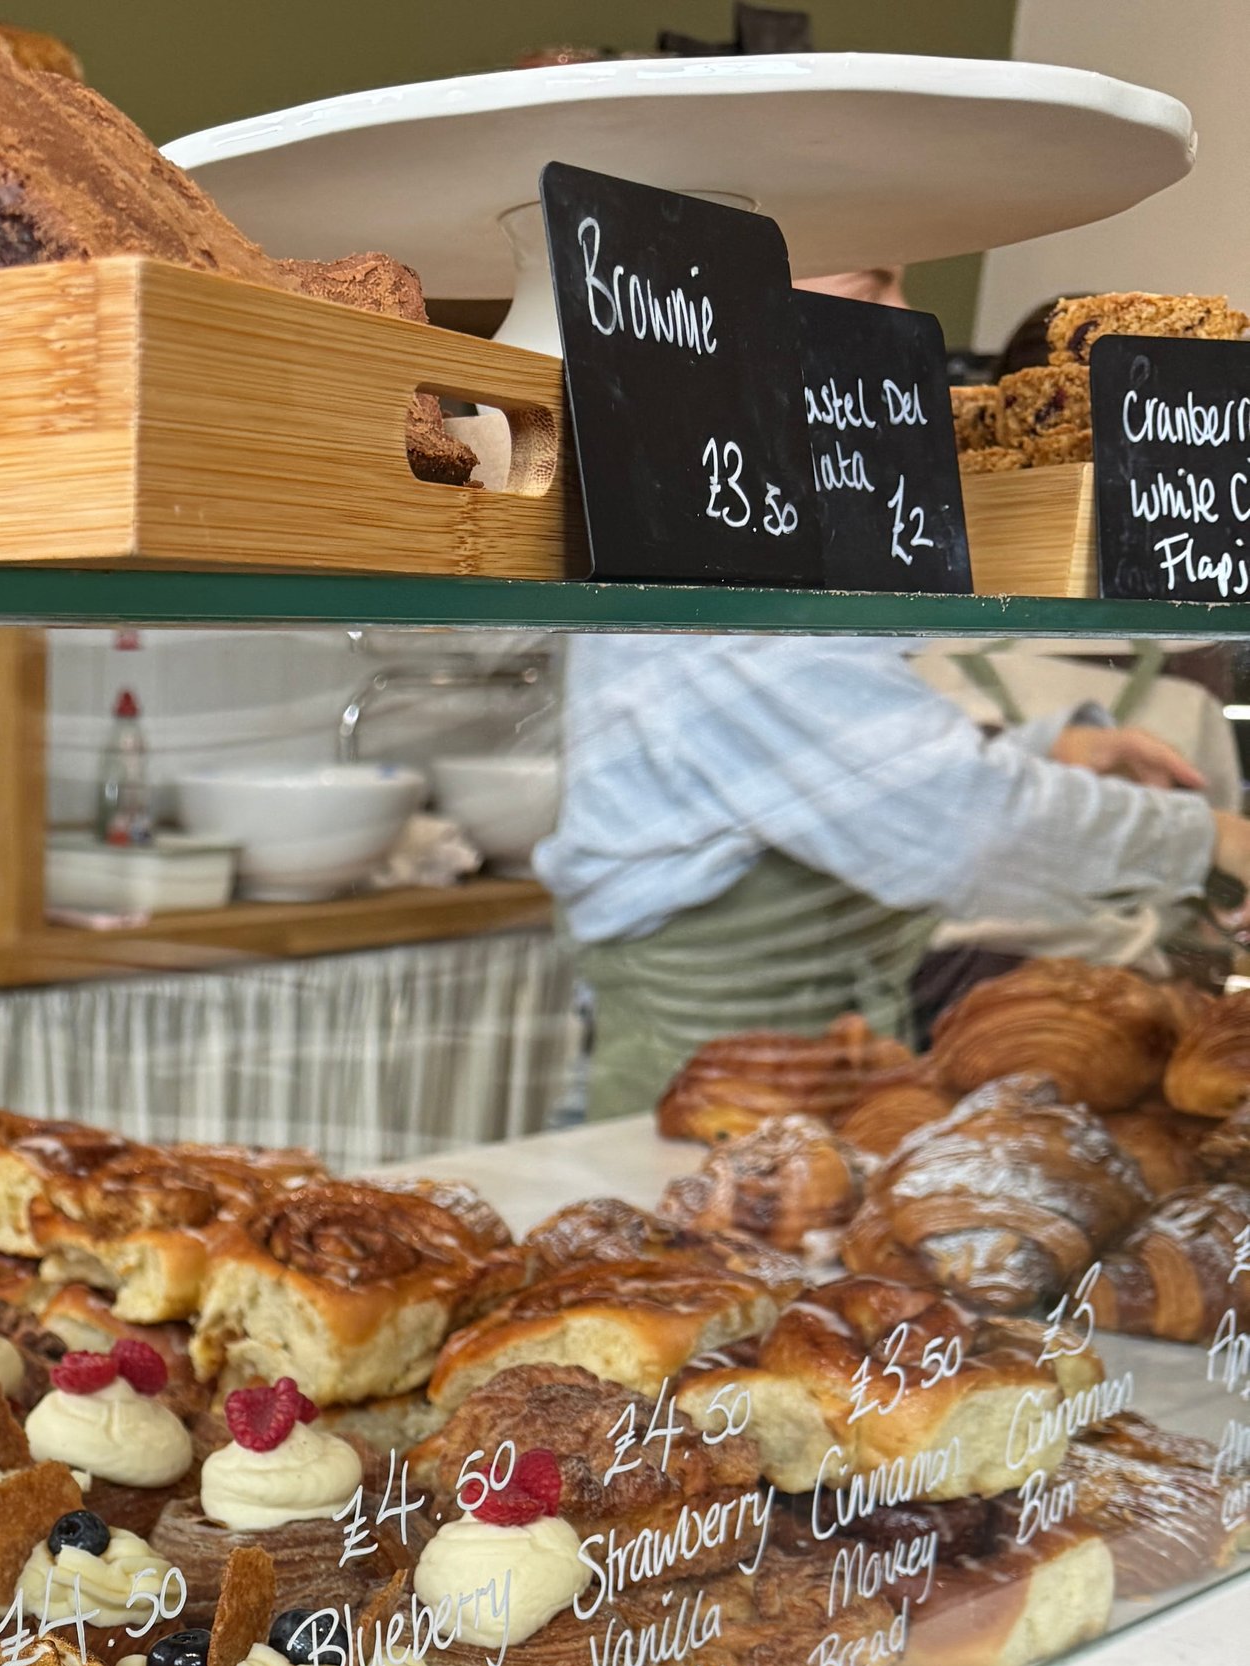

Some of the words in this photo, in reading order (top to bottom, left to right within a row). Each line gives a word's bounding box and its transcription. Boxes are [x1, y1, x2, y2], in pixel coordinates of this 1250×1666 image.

[577, 214, 719, 356] Brownie
[802, 376, 877, 431] astel
[1122, 389, 1250, 447] Cranberr
[698, 436, 800, 538] £3.50
[886, 474, 934, 566] £2
[602, 1376, 751, 1487] £4.50
[332, 1439, 517, 1568] £4.50
[572, 1485, 776, 1621] Strawberry
[1015, 1468, 1076, 1546] Bun
